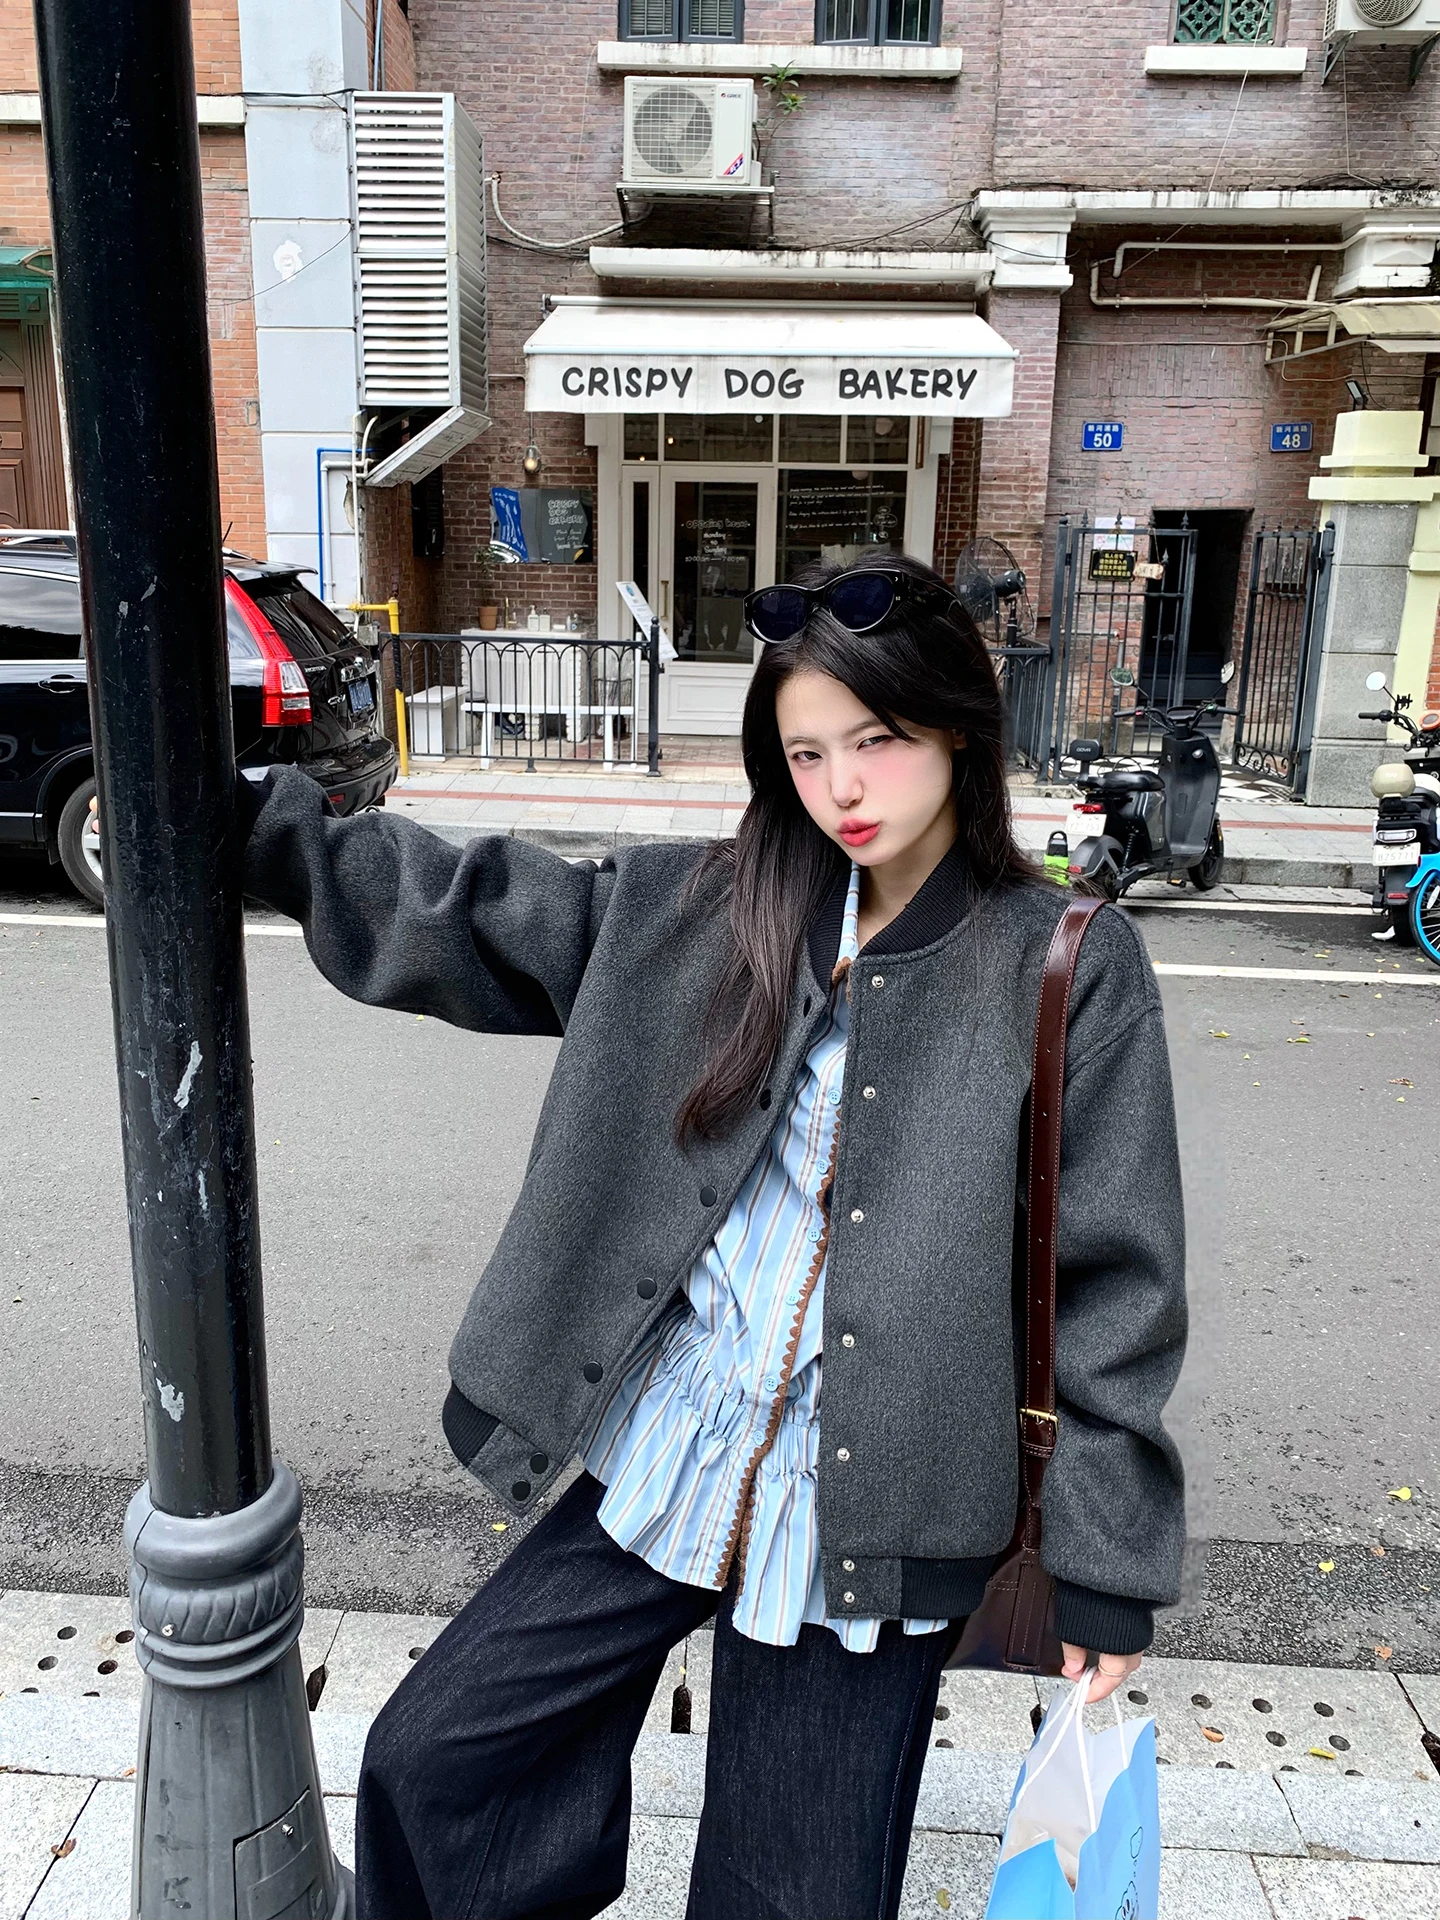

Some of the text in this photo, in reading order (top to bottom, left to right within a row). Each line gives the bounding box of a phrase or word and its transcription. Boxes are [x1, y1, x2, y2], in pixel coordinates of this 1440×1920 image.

[562, 367, 978, 400] CRISPY DOG BAKERY
[1093, 433, 1112, 447] 50
[1281, 433, 1301, 448] 48
